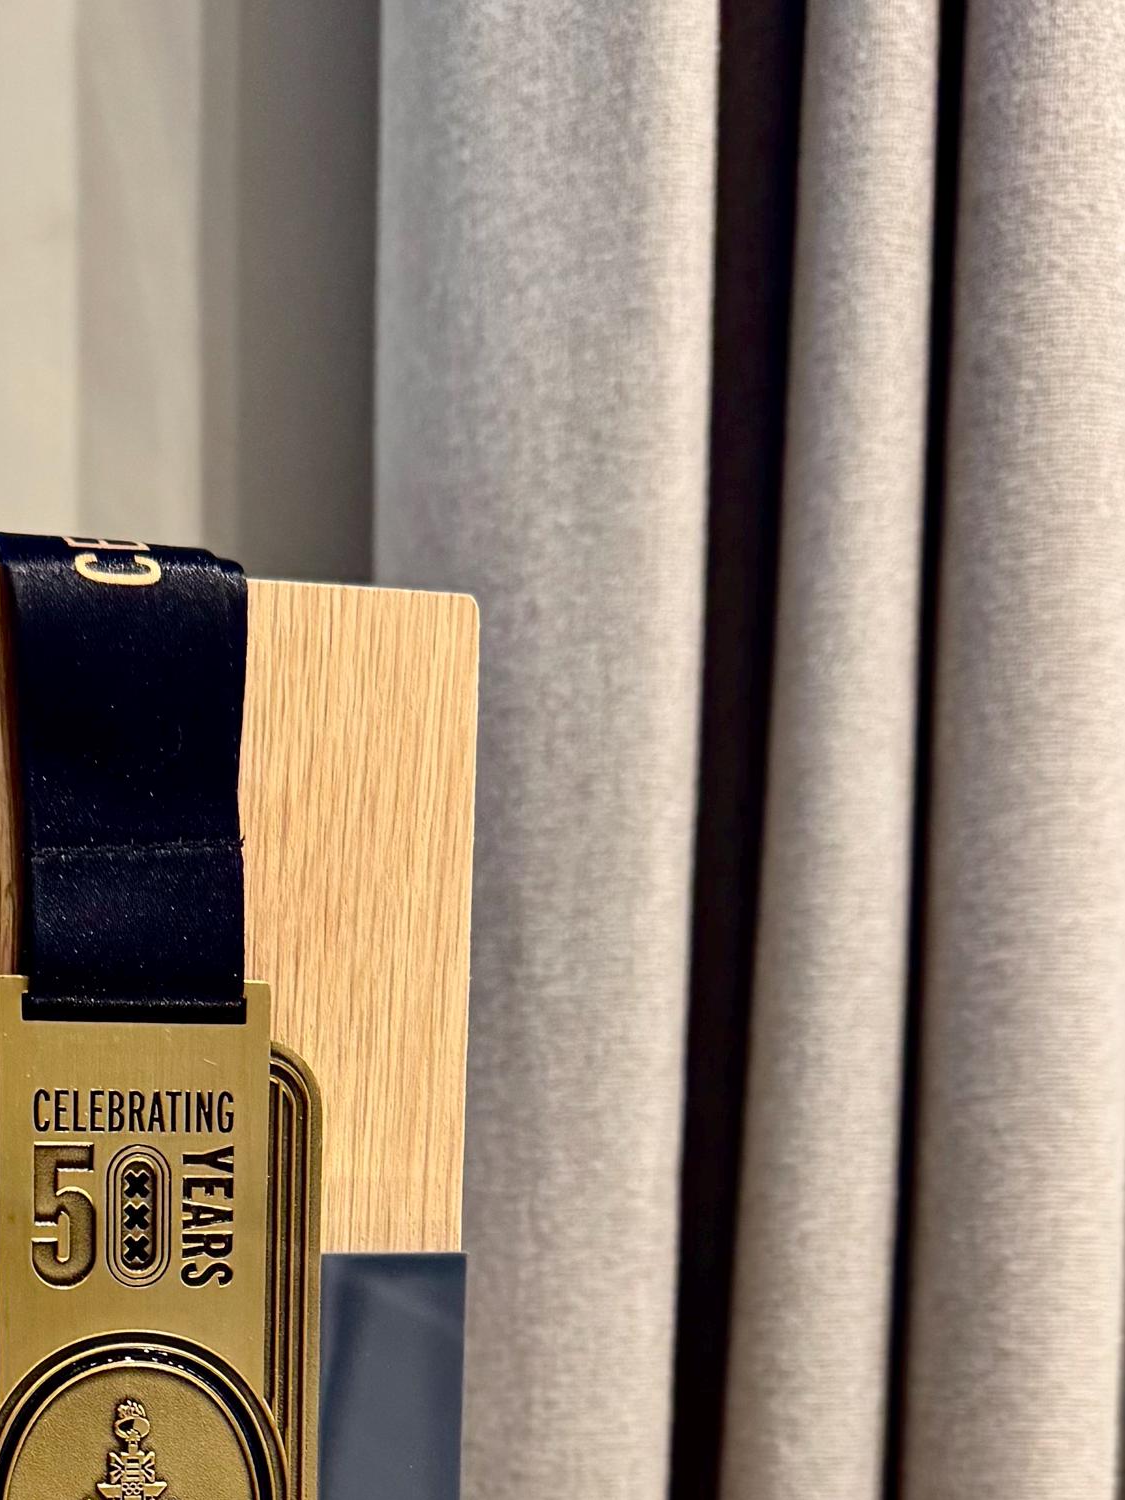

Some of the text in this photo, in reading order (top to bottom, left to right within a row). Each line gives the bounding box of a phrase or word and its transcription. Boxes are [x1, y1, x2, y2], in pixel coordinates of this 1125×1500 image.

[33, 1088, 235, 1134] CELEBRATING
[31, 1141, 172, 1290] 50
[180, 1145, 235, 1289] YEARS
